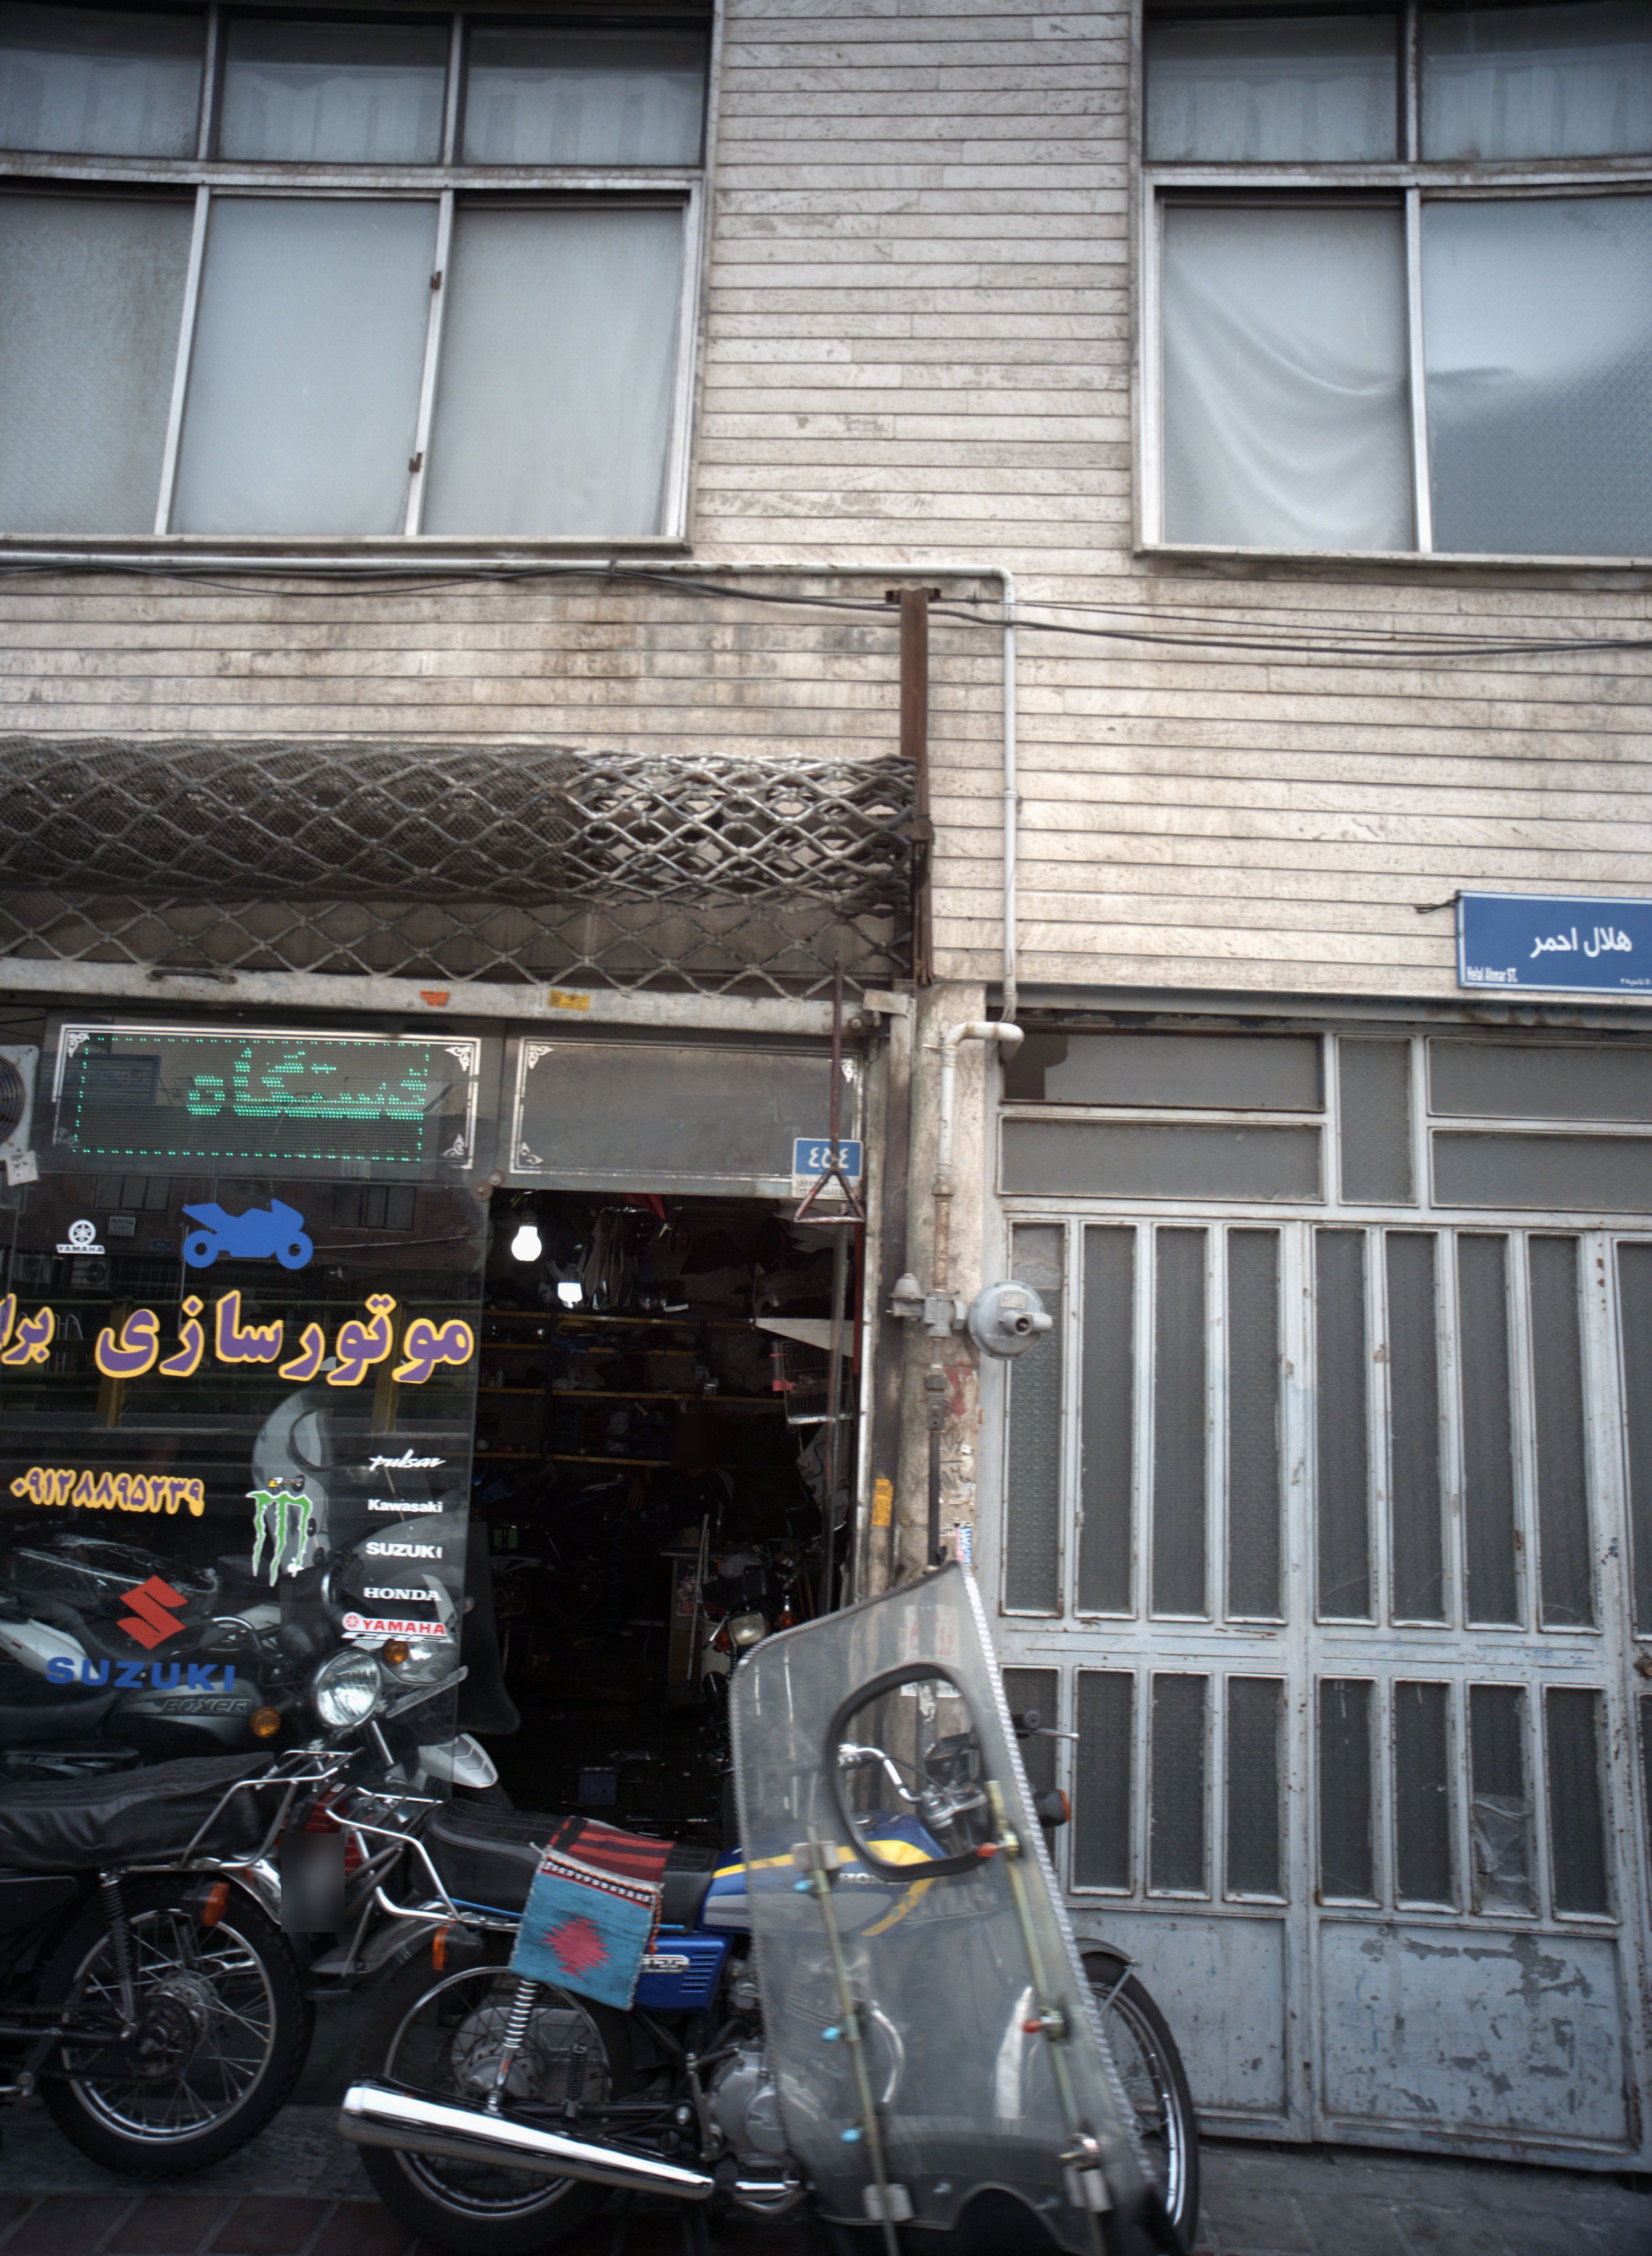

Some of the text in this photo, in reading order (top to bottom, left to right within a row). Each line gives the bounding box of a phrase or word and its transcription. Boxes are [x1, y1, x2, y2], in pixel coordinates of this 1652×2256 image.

[1530, 927, 1632, 958] هلال احمر
[367, 1499, 443, 1512] Kawasaki
[366, 1542, 442, 1559] SUZUKI
[363, 1587, 442, 1601] HONDA
[362, 1619, 445, 1635] YAMAHA
[46, 1657, 235, 1692] SUZUKI
[162, 1699, 252, 1713] BOXER
